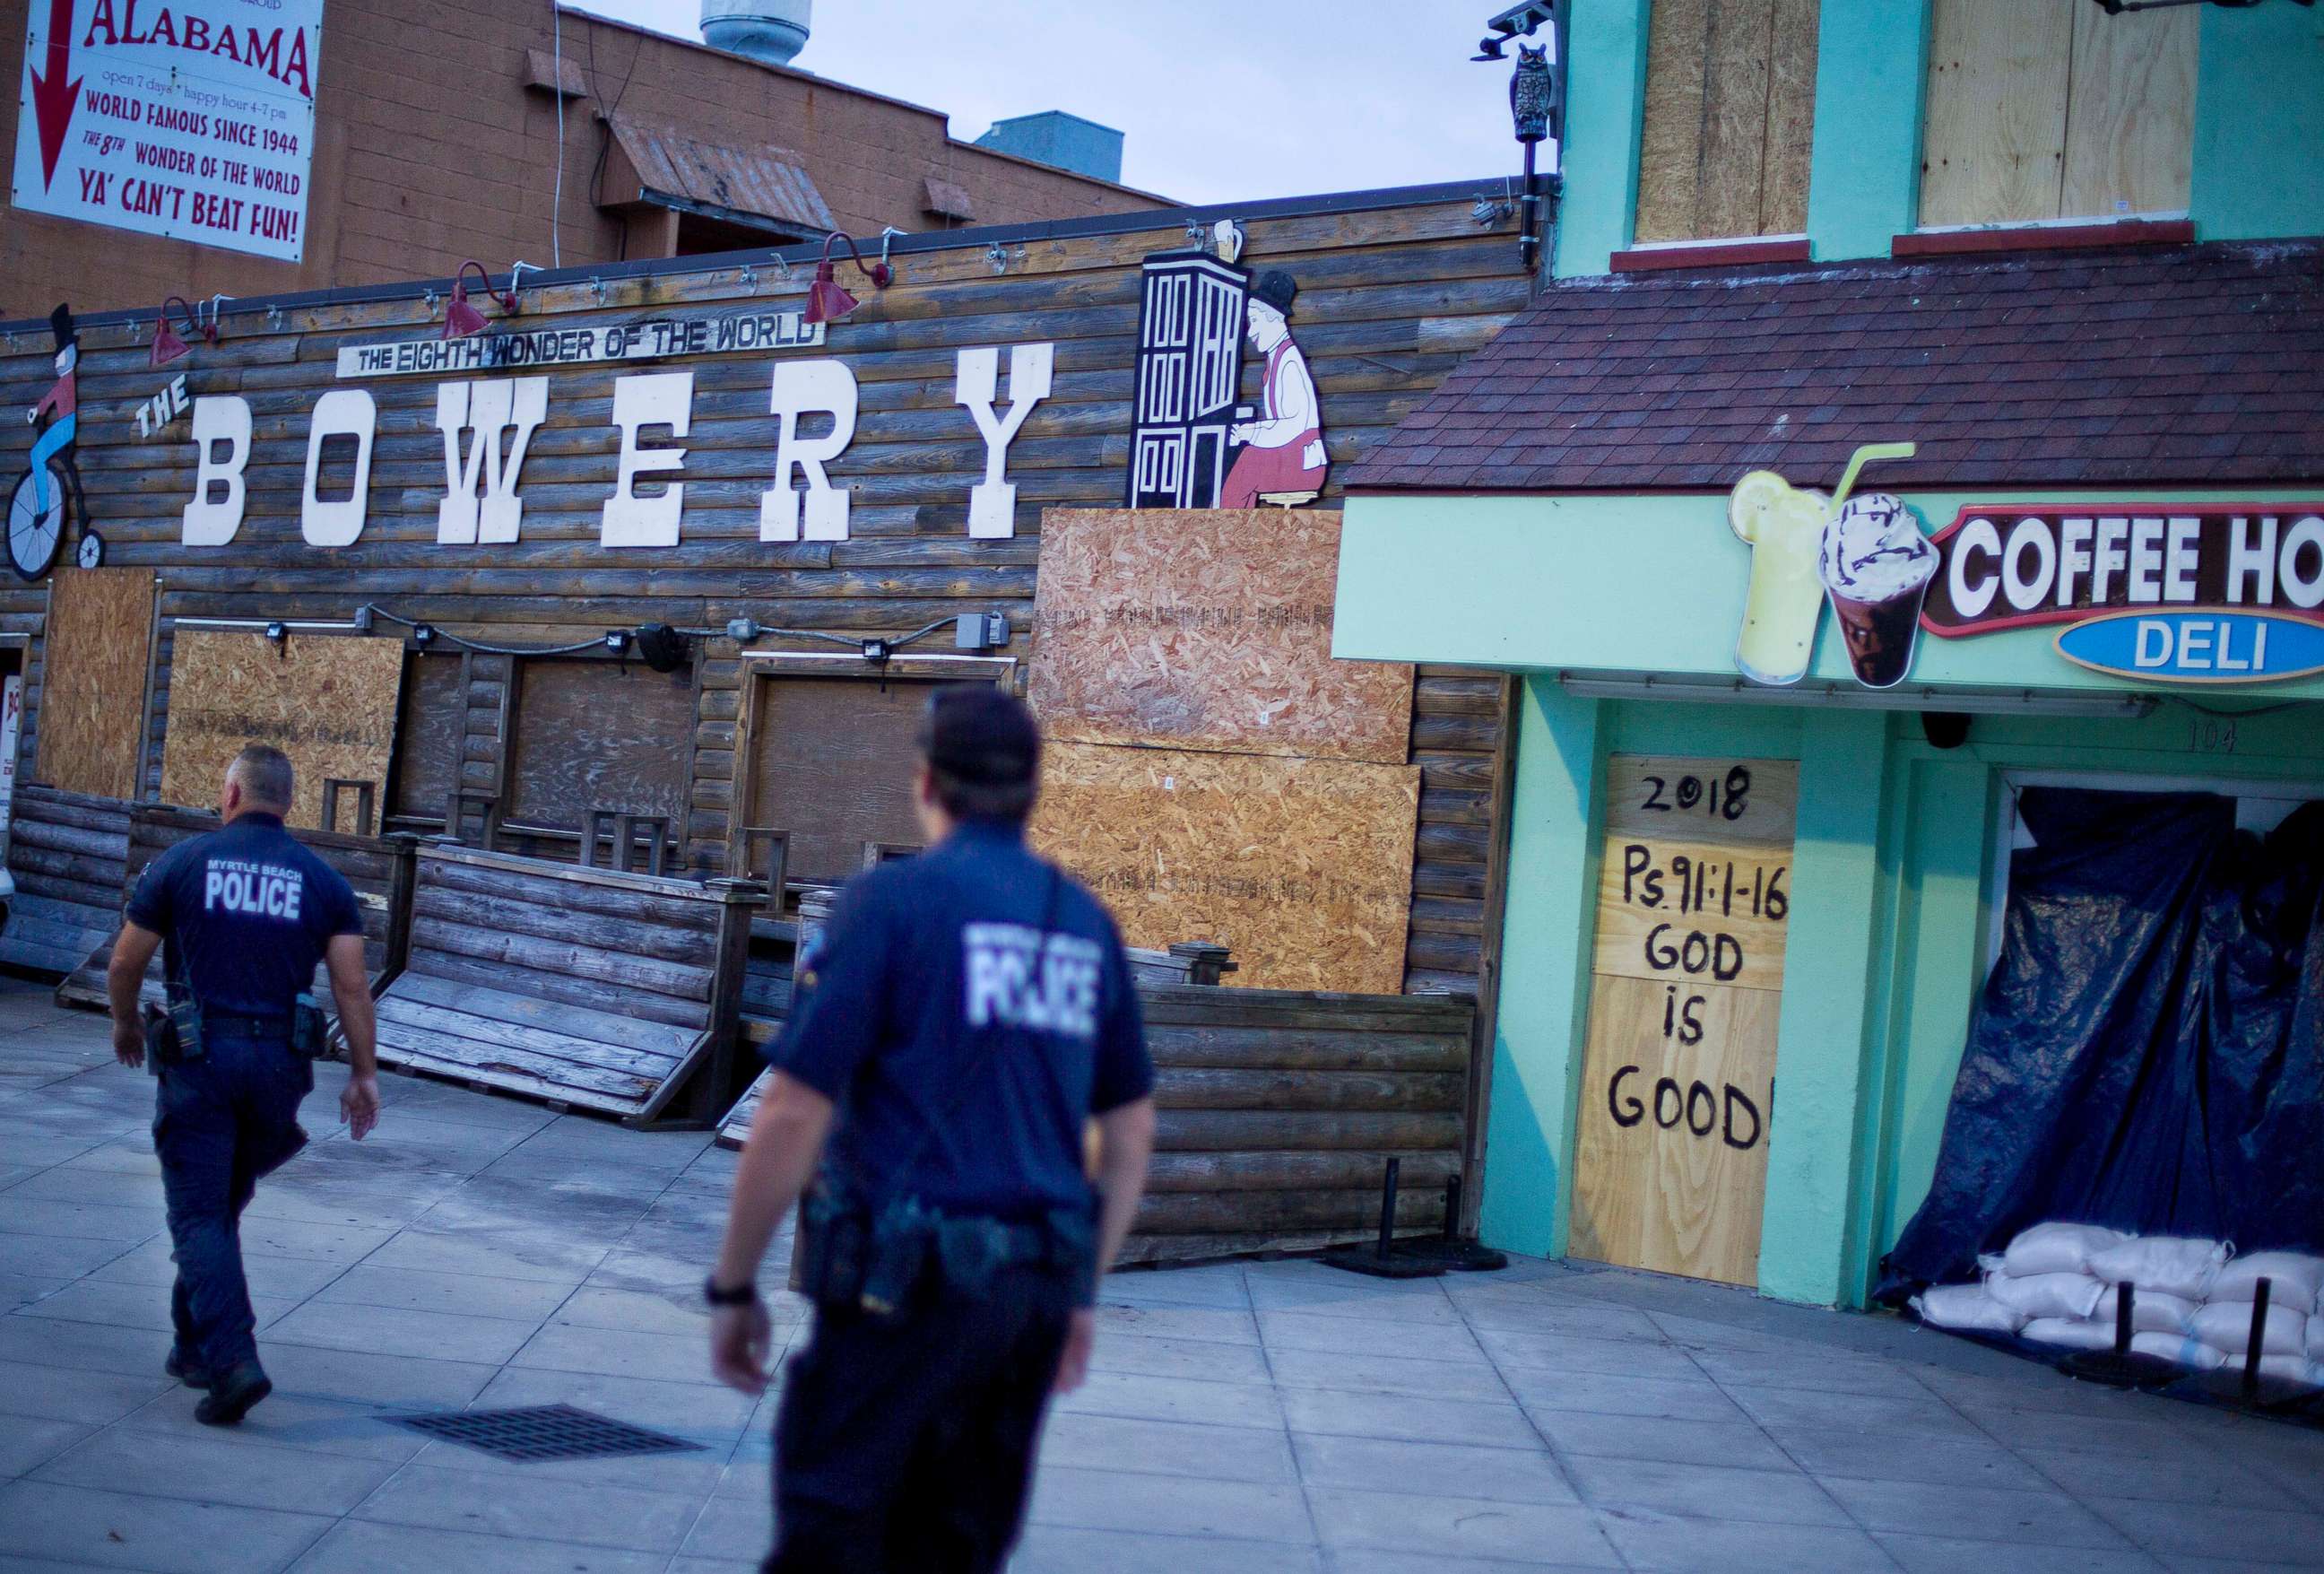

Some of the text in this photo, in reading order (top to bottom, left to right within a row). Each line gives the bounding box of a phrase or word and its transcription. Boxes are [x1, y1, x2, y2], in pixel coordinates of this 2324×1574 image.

[83, 0, 312, 98] ALABAMA
[86, 90, 299, 155] WORLD FAMOUS SINCE 1944
[102, 70, 287, 120] open 7 days happy hour 4-7 pm
[82, 130, 300, 196] THE 8TH WONDER OF THE WORLD
[79, 167, 299, 243] YA' CAN'T BEAT FUN!
[359, 314, 815, 371] THE EIGHTH WONDER OF THE WORLD
[135, 373, 190, 439] THE
[181, 343, 1055, 548] BOWERY
[1949, 517, 2201, 618] COFFEE
[2134, 620, 2268, 671] DELI
[2189, 718, 2237, 752] 104
[1641, 765, 1751, 820] 2018
[205, 872, 302, 919] POLICE
[207, 859, 302, 883] MYRTLE BEACH
[1644, 923, 1743, 981] GOD
